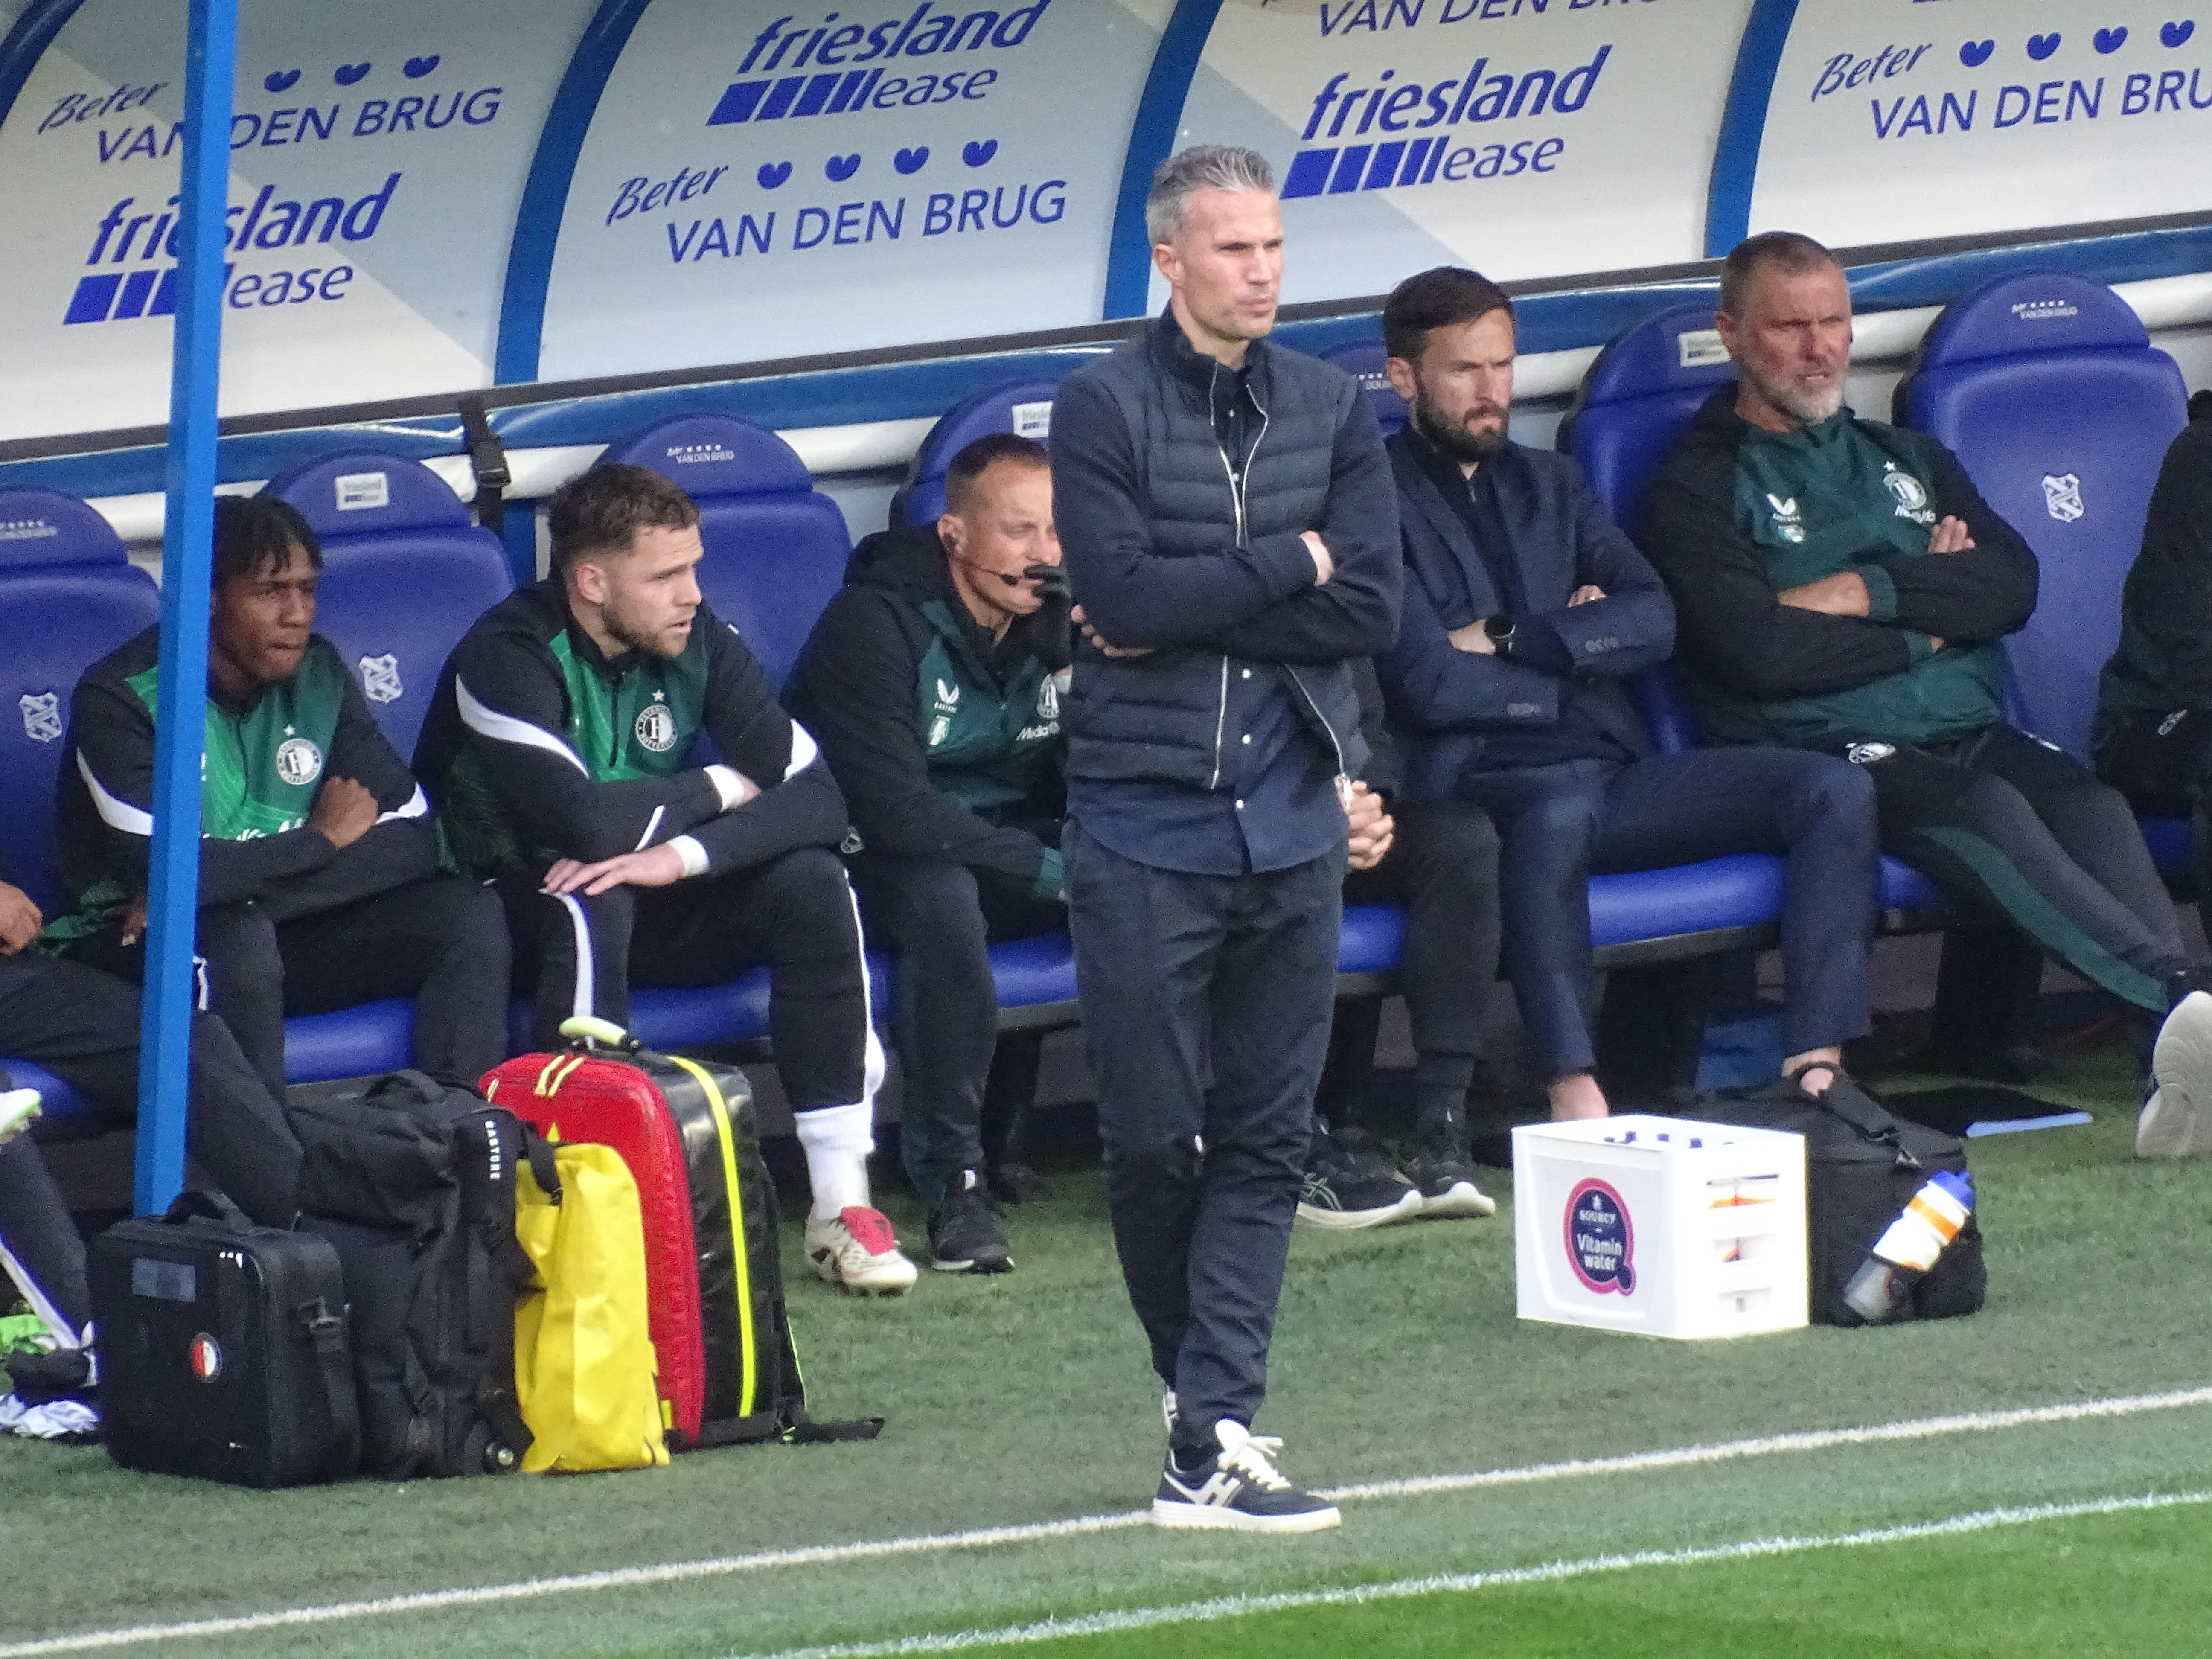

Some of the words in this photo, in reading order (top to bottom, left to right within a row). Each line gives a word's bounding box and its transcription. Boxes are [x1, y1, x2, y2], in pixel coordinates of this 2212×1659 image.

[736, 0, 1052, 74] friesland
[1320, 0, 1426, 37] VAN
[849, 68, 998, 112] lease
[1301, 44, 1613, 140] friesland
[1810, 43, 1933, 102] Beter
[38, 82, 167, 134] Beter
[352, 87, 503, 136] BRUG
[1871, 90, 1977, 139] VAN
[1994, 77, 2105, 128] DEN
[1420, 135, 1565, 184] lease
[606, 165, 729, 226] Beter
[667, 212, 776, 263] VAN
[792, 198, 905, 250] DEN
[923, 180, 1068, 236] BRUG
[1577, 1232, 1623, 1256] Vitamin
[1584, 1254, 1617, 1270] water
